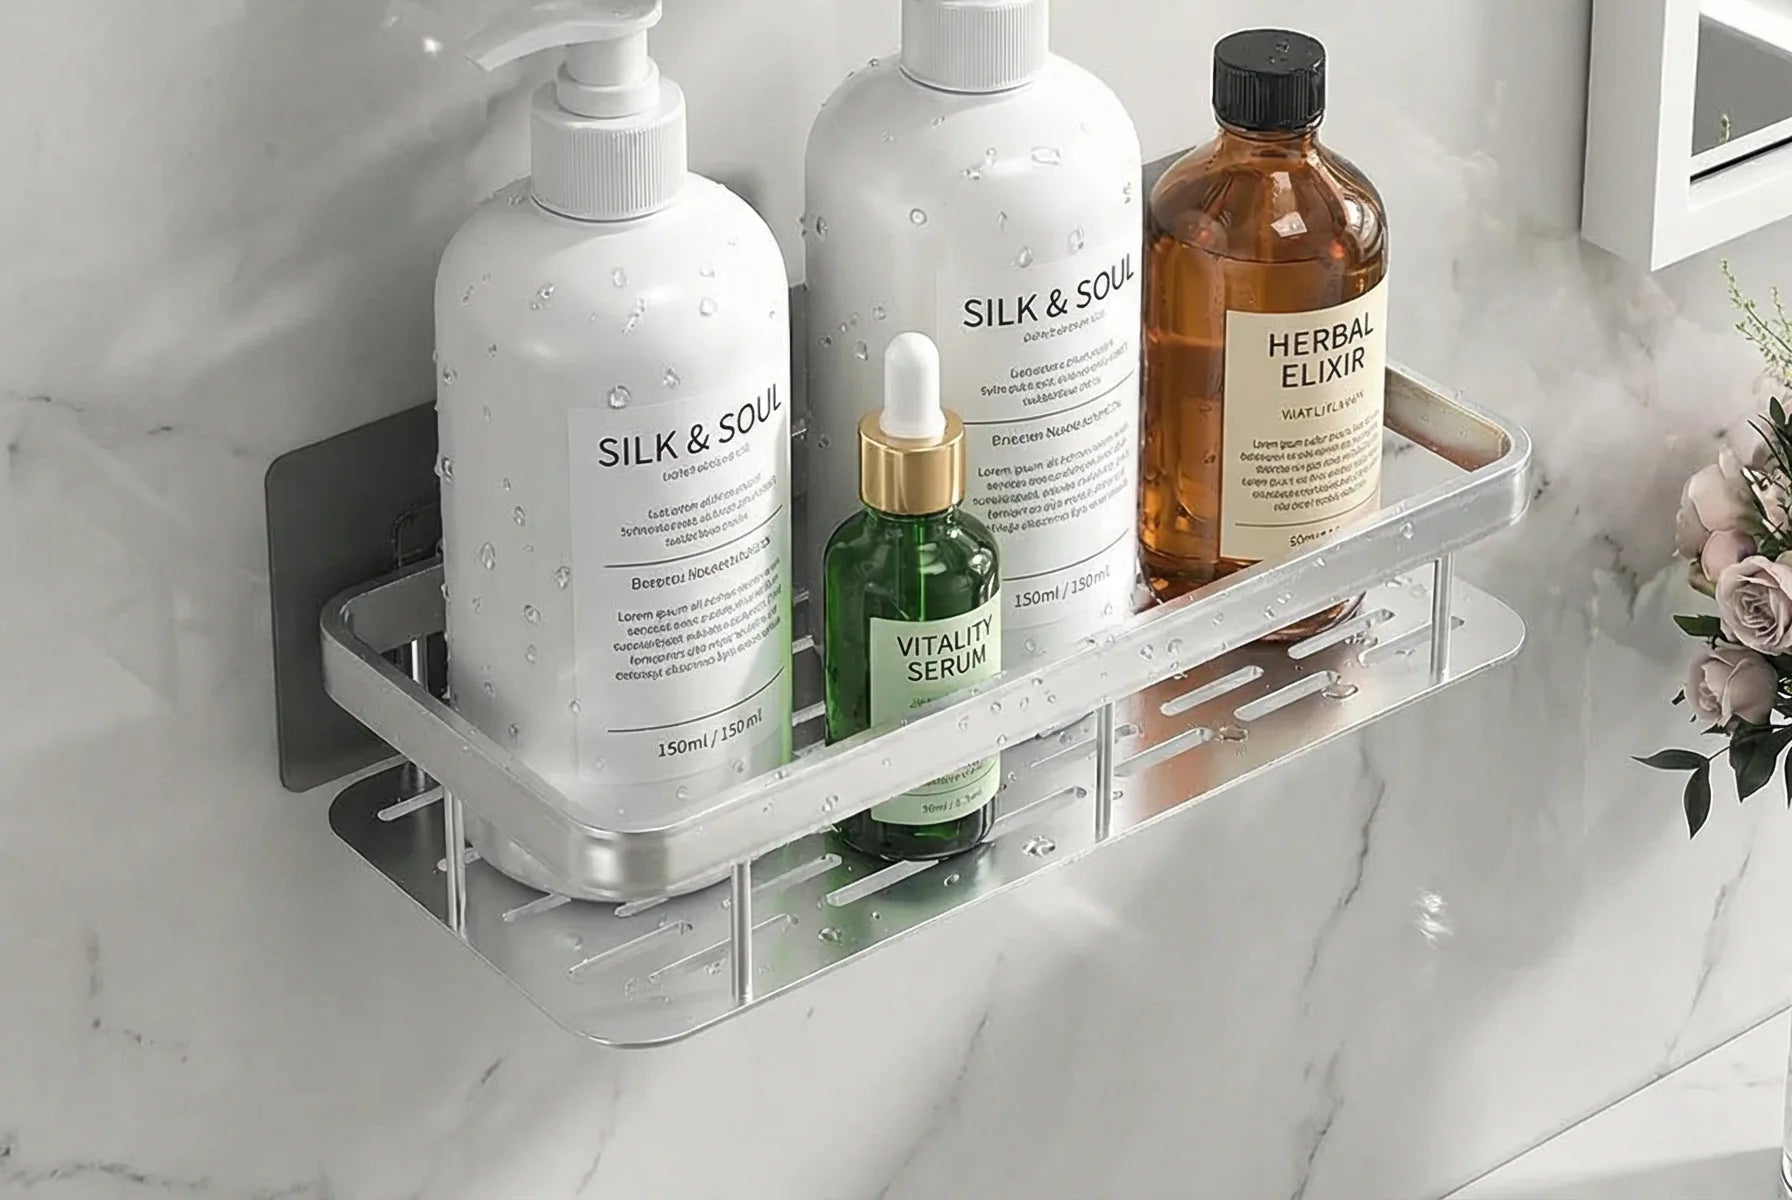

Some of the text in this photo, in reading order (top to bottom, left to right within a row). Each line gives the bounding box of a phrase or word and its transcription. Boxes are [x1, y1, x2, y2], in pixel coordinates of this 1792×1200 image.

[963, 293, 1039, 329] SILK
[1046, 288, 1068, 317] &
[1076, 253, 1134, 308] SOUL
[1269, 312, 1374, 357] HERBAL
[1282, 346, 1365, 388] ELIXIR
[598, 429, 678, 468] SILK
[686, 423, 710, 455] &
[718, 383, 781, 445] SOUL
[897, 613, 993, 657] VITALITY
[907, 644, 986, 682] SERUM
[658, 733, 708, 757] 150ml
